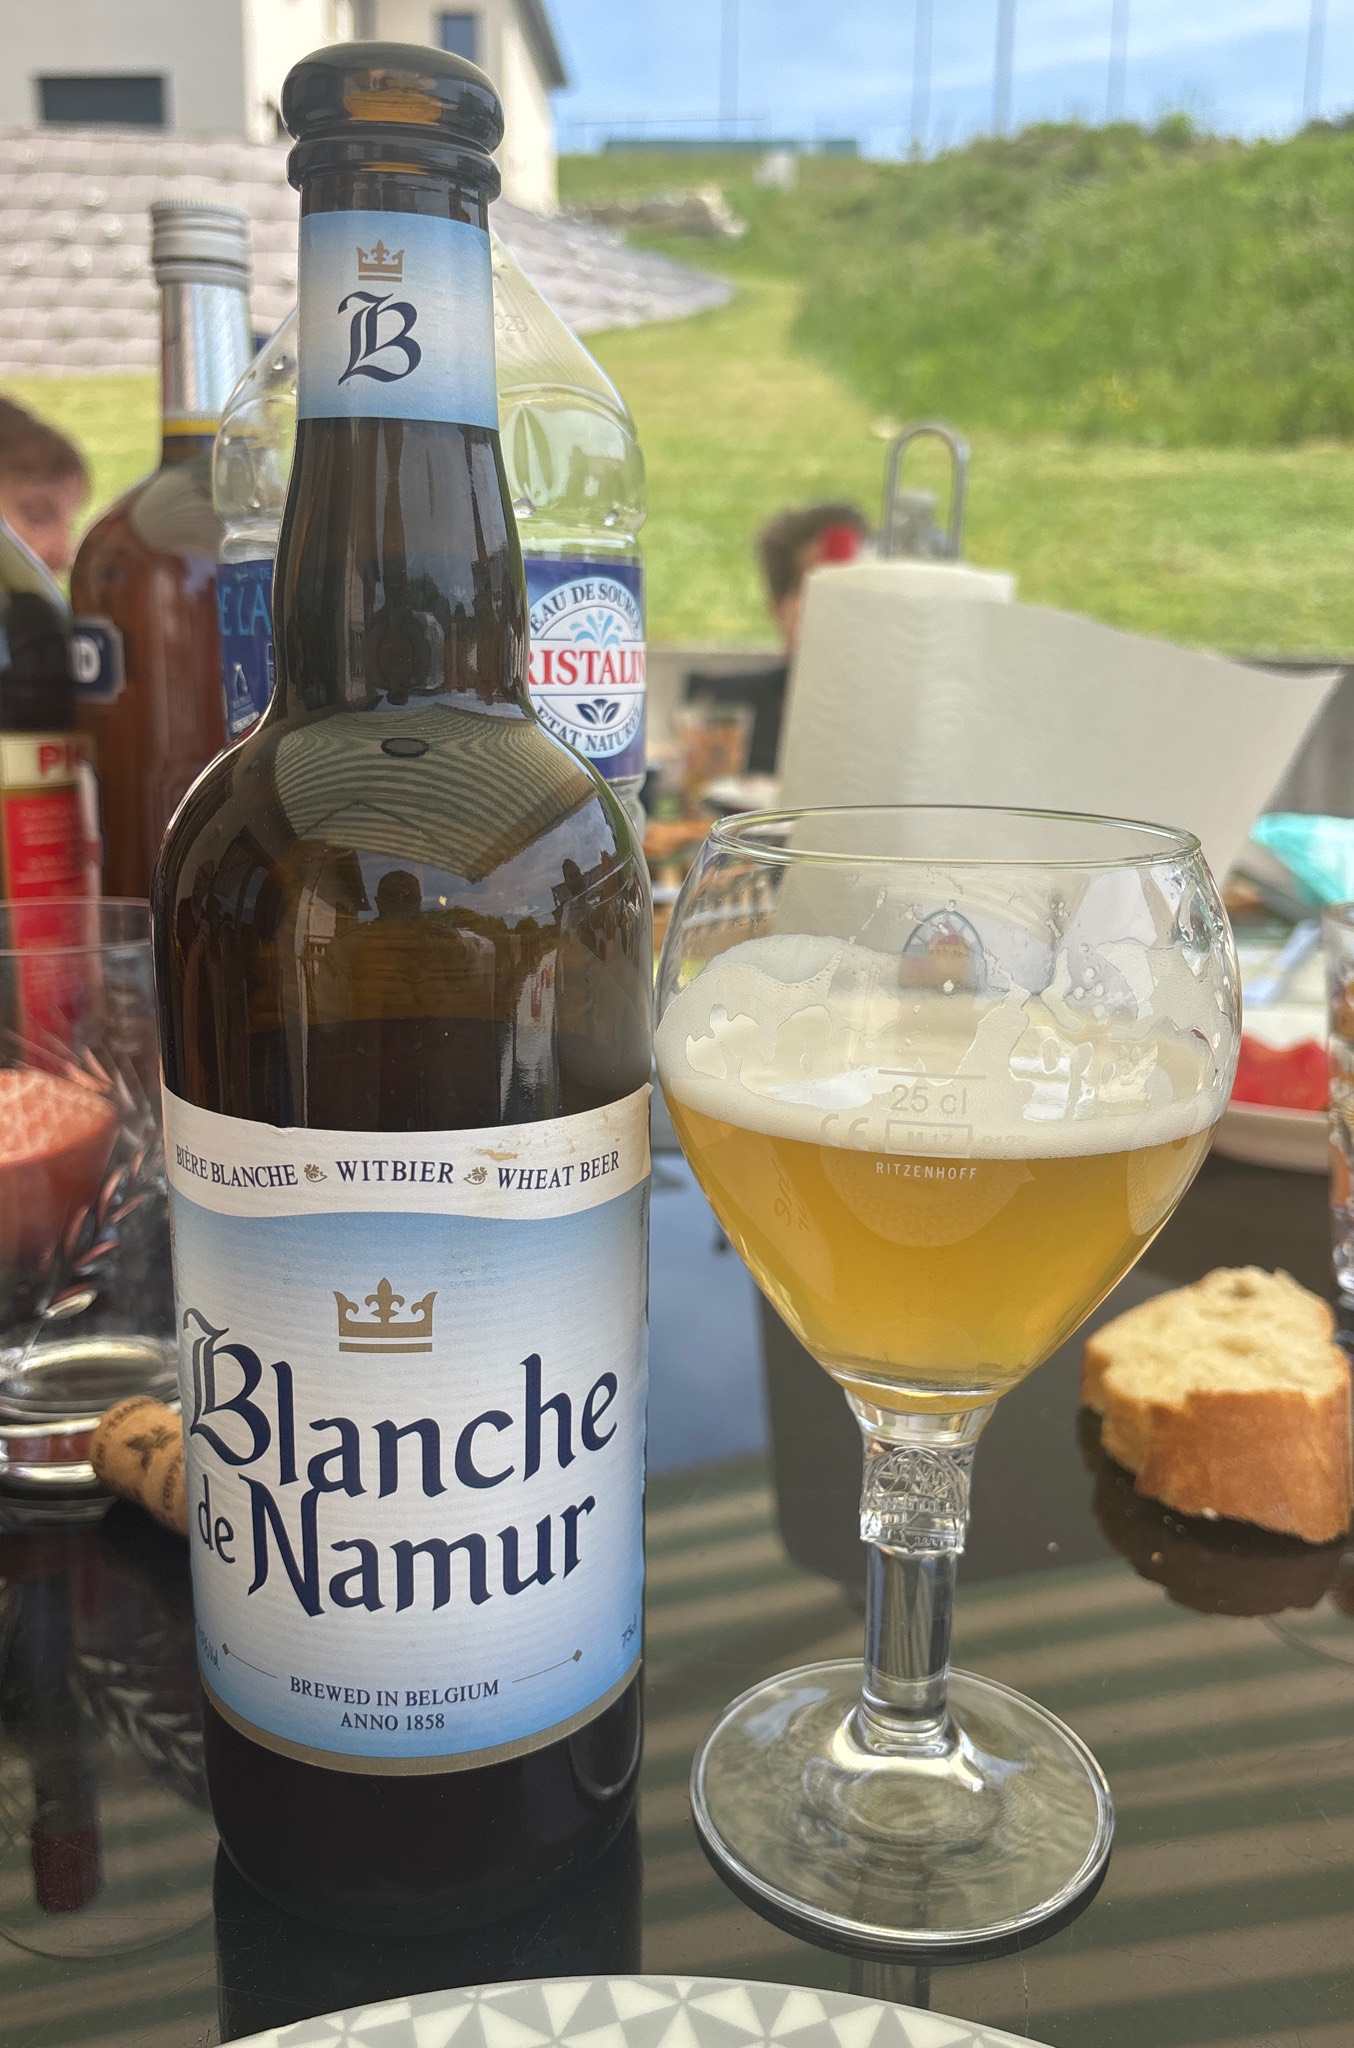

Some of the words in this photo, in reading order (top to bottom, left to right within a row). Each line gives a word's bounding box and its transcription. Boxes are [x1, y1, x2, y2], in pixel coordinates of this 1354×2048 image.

[338, 291, 422, 386] B
[530, 587, 568, 634] EAU
[570, 583, 596, 606] DE
[598, 582, 642, 640] SOURC
[889, 1083, 929, 1113] 25
[939, 1086, 967, 1115] cl
[175, 1143, 209, 1180] BIÈRE
[210, 1161, 299, 1188] BLANCHE
[335, 1159, 455, 1184] WITBIER
[497, 1165, 575, 1190] WHEAT
[579, 1150, 620, 1183] BEER
[876, 1161, 978, 1180] RITZENHOFF
[183, 1307, 619, 1499] Blanche
[197, 1473, 237, 1564] de
[237, 1472, 596, 1617] Namur
[290, 1675, 371, 1705] BREWED
[376, 1690, 399, 1706] IN
[405, 1678, 500, 1707] BELGIUM
[340, 1711, 399, 1731] ANNO
[406, 1712, 445, 1731] 1858
